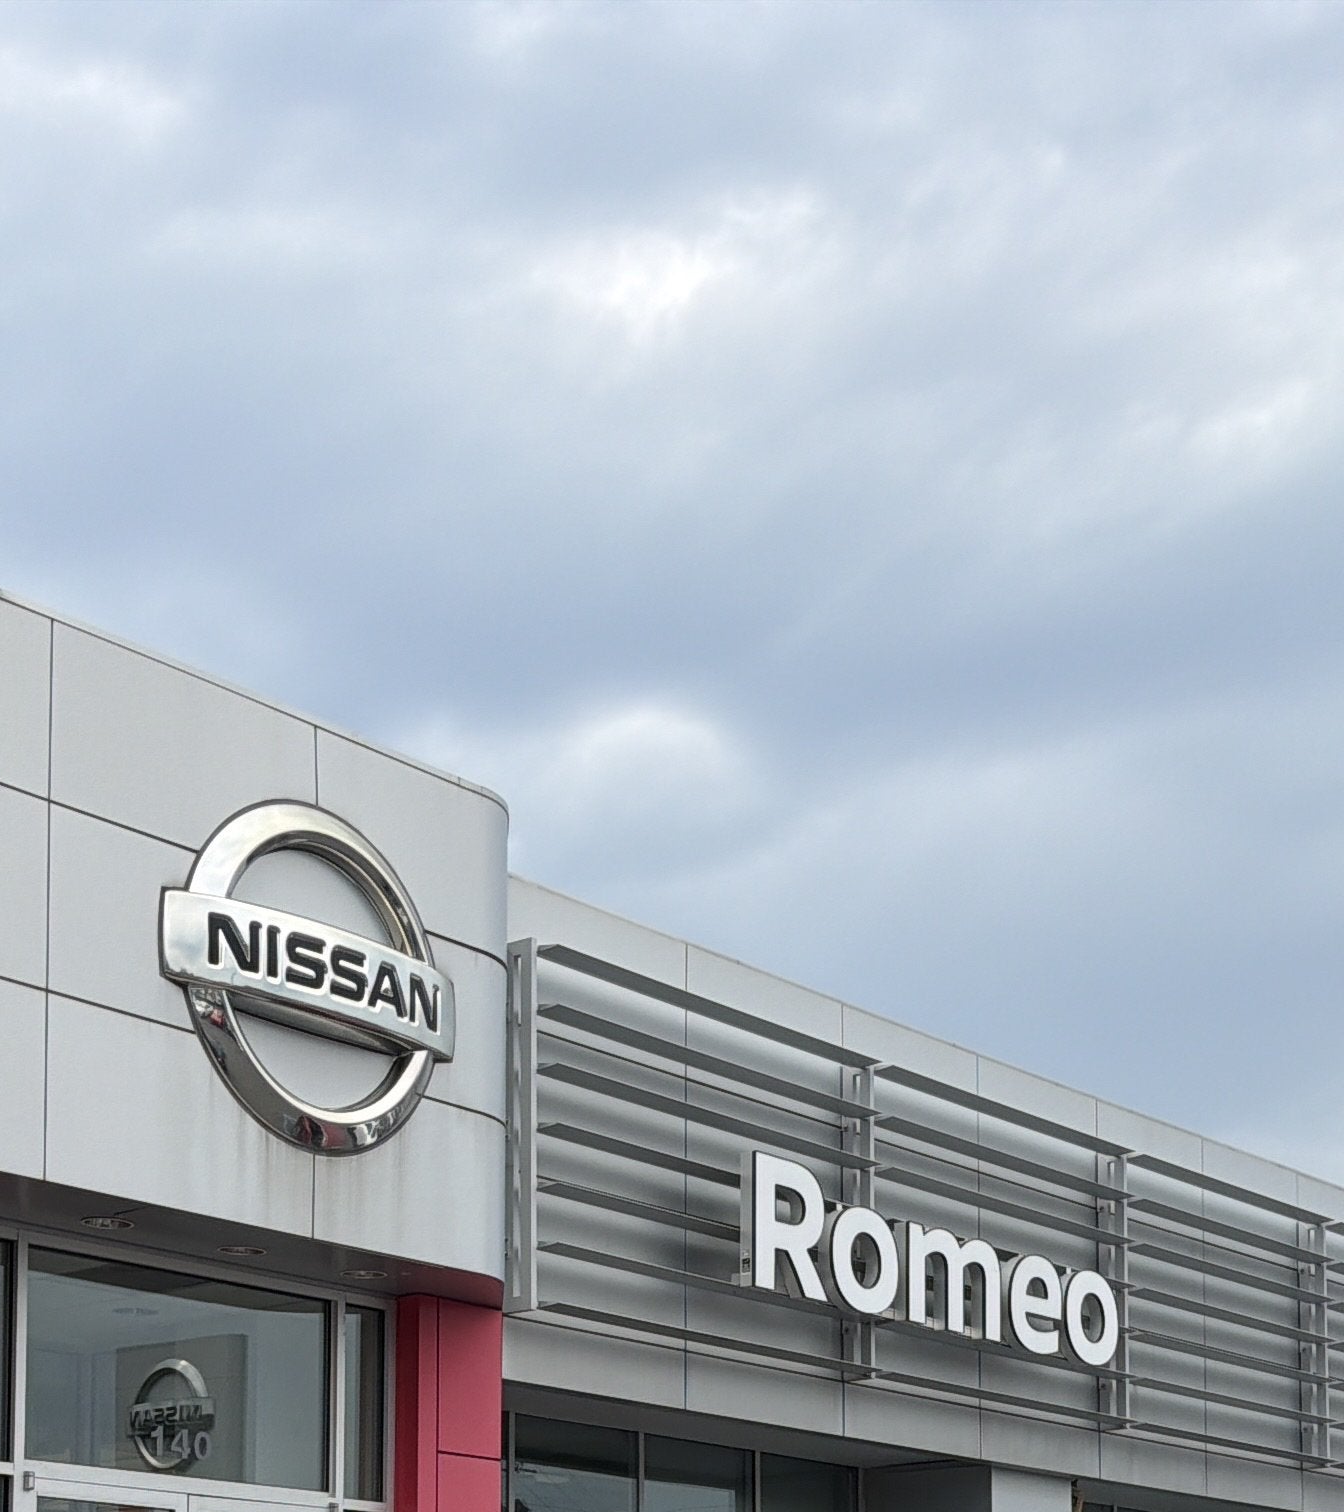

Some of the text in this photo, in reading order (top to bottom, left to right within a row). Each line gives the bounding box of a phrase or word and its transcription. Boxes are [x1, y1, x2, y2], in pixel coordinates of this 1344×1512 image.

[207, 911, 441, 1034] NISSAN
[753, 1149, 1119, 1367] Romeo
[150, 1424, 213, 1461] 140
